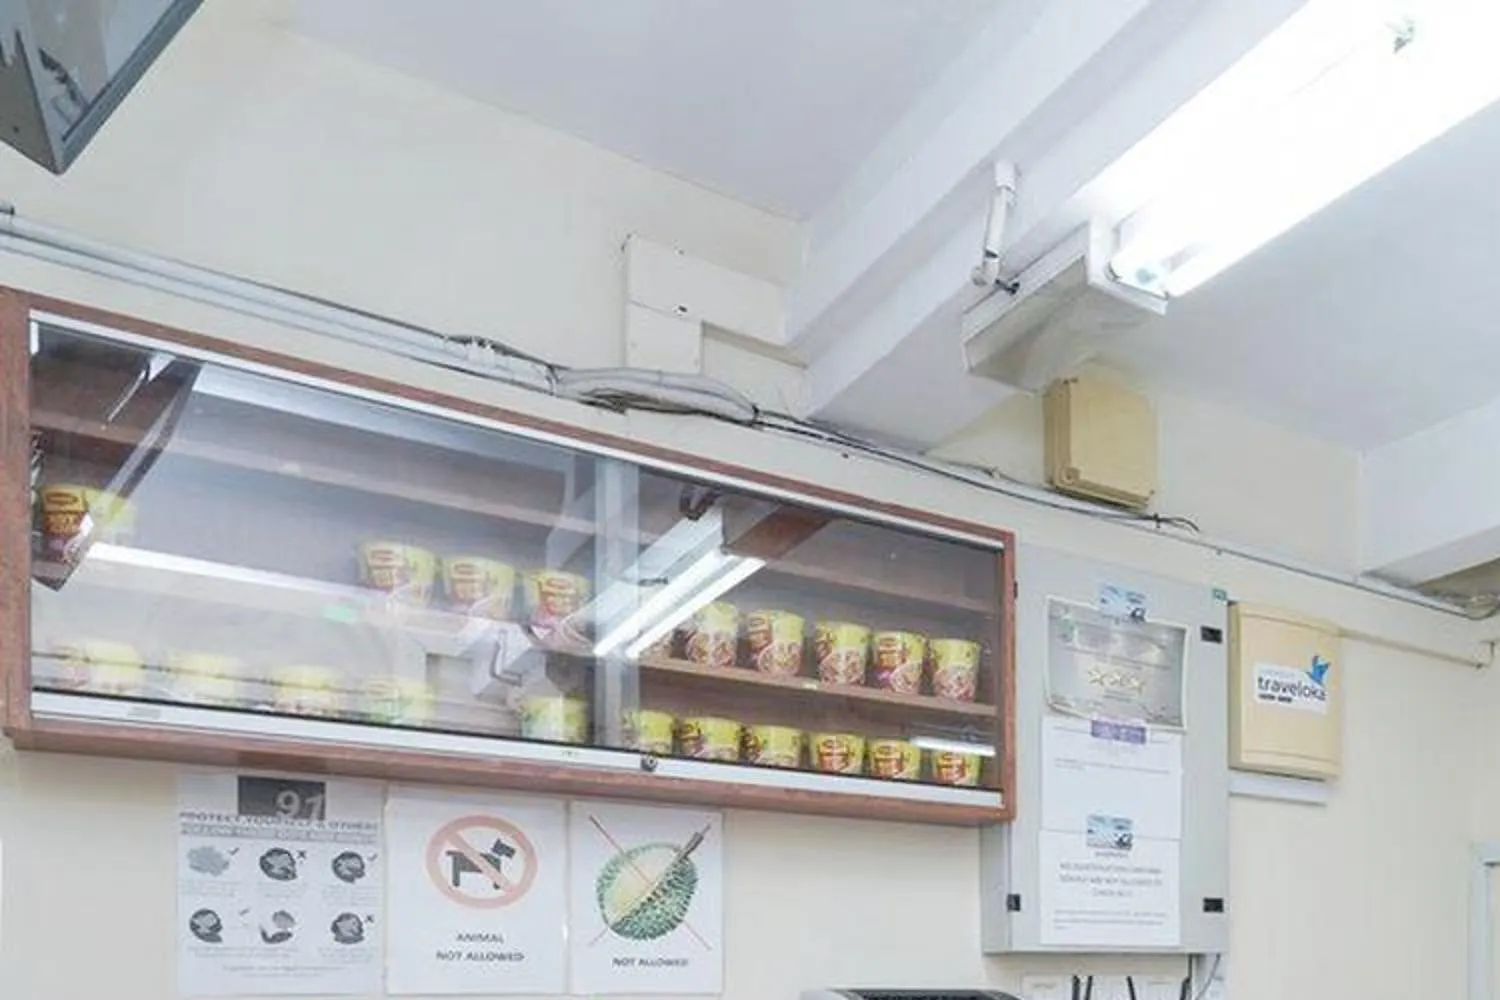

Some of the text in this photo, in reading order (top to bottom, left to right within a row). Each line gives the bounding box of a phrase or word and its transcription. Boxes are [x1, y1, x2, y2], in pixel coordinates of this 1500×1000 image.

[1257, 676, 1327, 701] traveloka
[456, 933, 504, 944] ANIMAL
[436, 951, 525, 963] NOT ALLOWED
[612, 957, 689, 968] NOT ALLOWED
